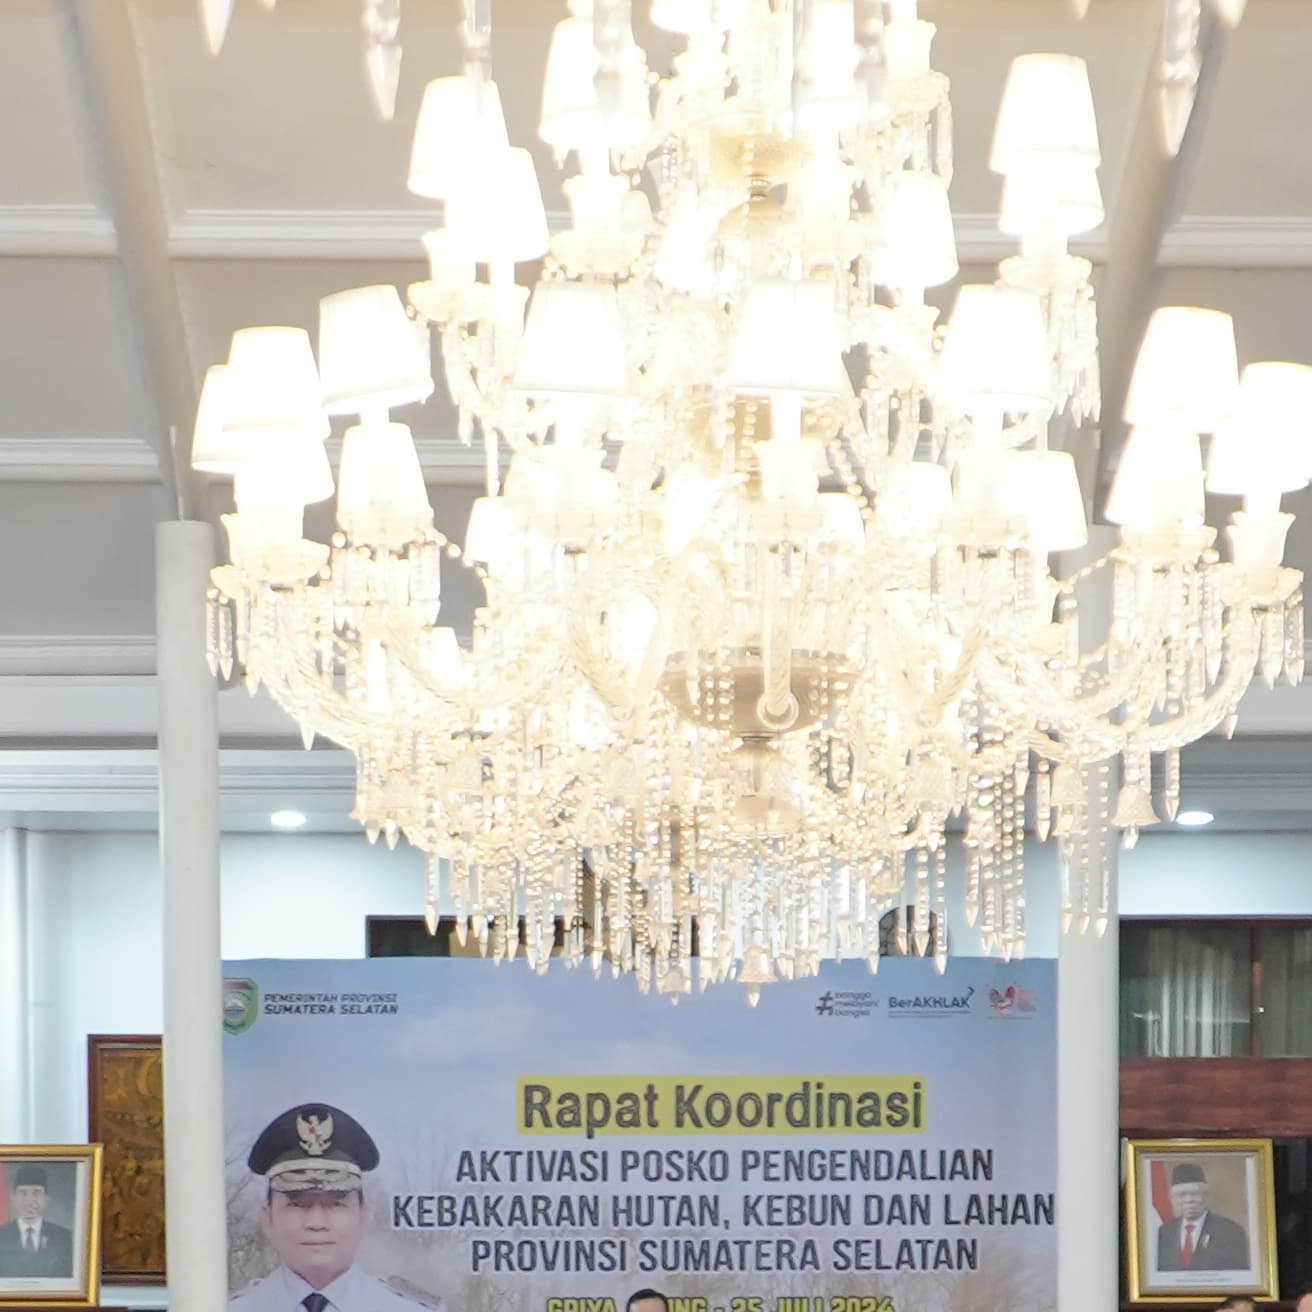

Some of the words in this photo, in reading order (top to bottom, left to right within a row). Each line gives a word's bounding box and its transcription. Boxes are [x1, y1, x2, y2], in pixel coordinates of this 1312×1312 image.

[263, 993, 338, 1003] PEMERINTAH
[340, 993, 399, 1003] PROVINSI
[263, 1003, 336, 1016] SUMATERA
[339, 1003, 400, 1016] SELATAN
[887, 995, 971, 1009] BerAKHLAK
[522, 1082, 660, 1140] Rapat
[673, 1080, 923, 1129] Koordinasi
[454, 1149, 610, 1183] AKTIVASI
[619, 1149, 731, 1183] POSKO
[740, 1148, 994, 1182] PENGENDALIAN
[392, 1194, 600, 1228] KEBAKARAN
[611, 1194, 731, 1231] HUTAN,
[742, 1193, 852, 1227] KEBUN
[863, 1193, 932, 1226] DAN
[943, 1192, 1056, 1226] LAHAN
[470, 1239, 627, 1273] PROVINSI
[638, 1238, 822, 1273] SUMATERA
[831, 1237, 979, 1271] SELATAN
